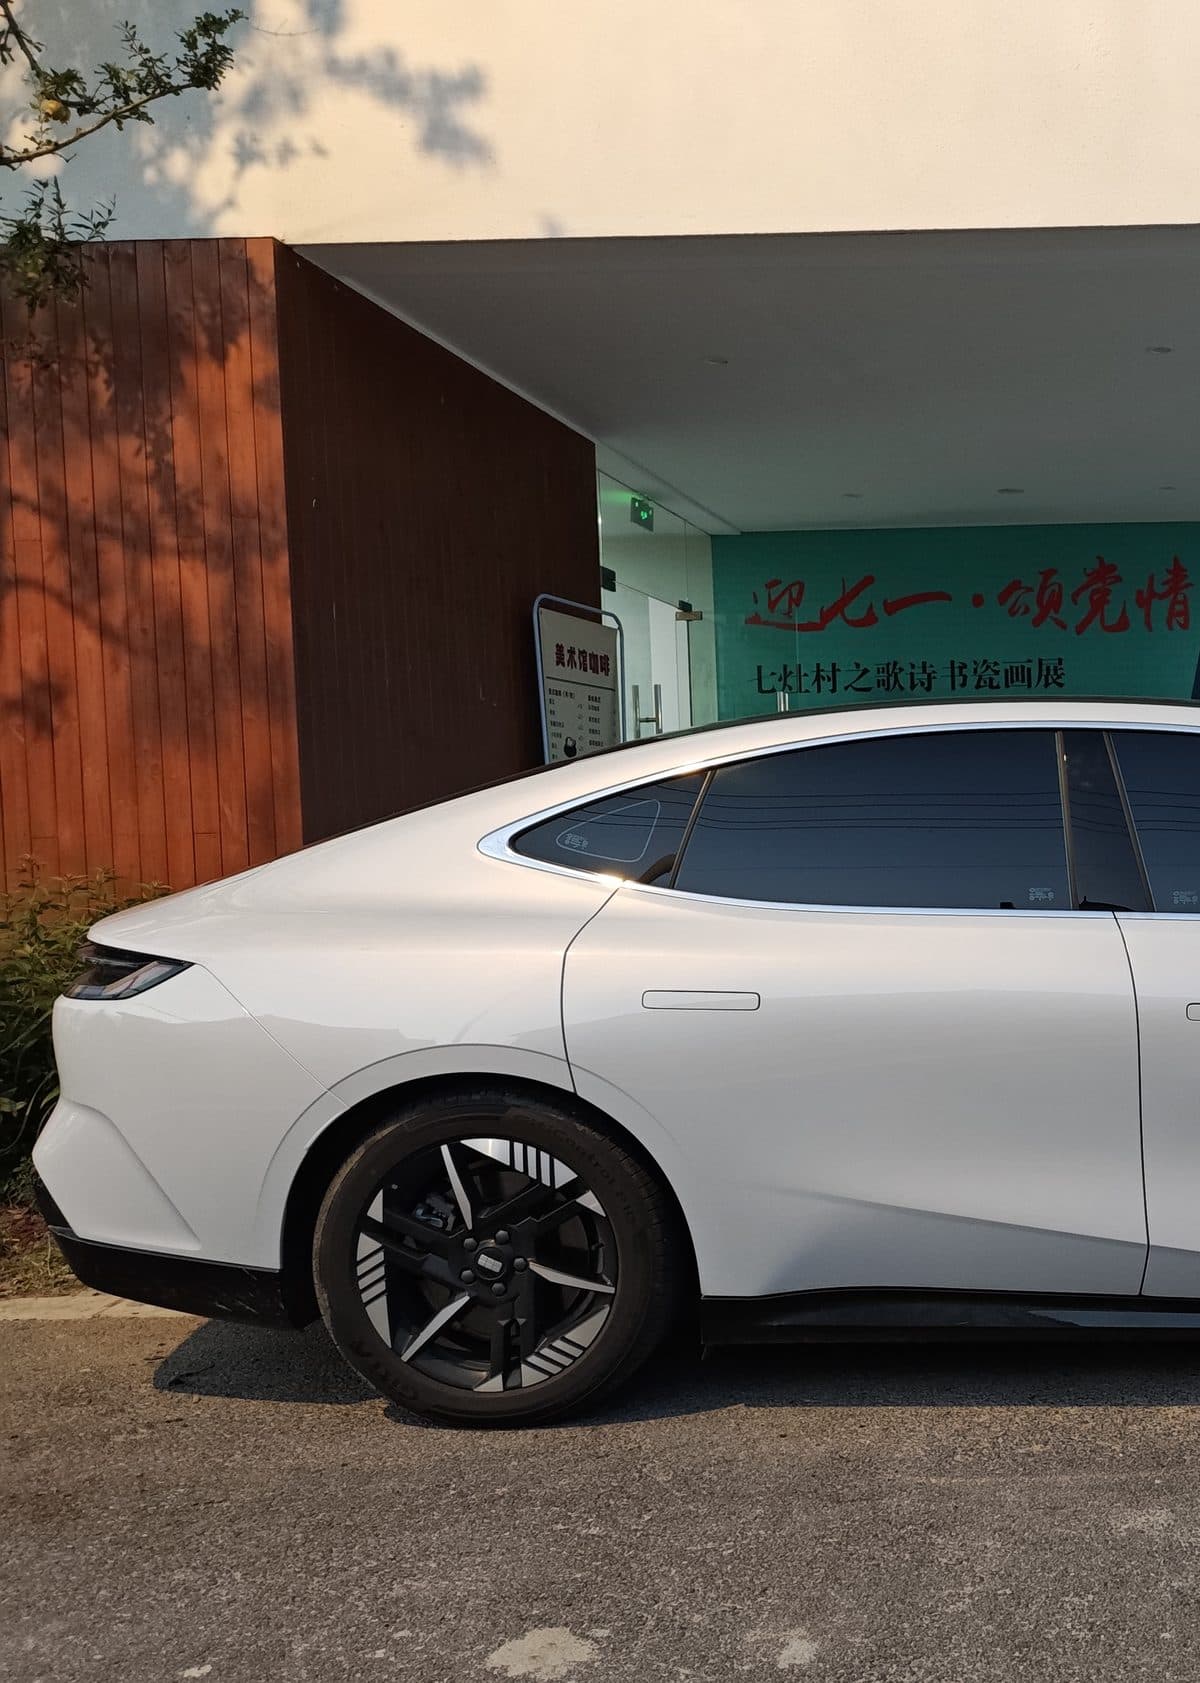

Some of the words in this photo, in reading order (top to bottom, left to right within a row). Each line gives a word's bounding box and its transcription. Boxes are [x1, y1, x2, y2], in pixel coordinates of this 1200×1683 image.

[555, 642, 610, 677] 美术馆咖啡
[752, 656, 1066, 695] 七灶村之歌诗书瓷画展
